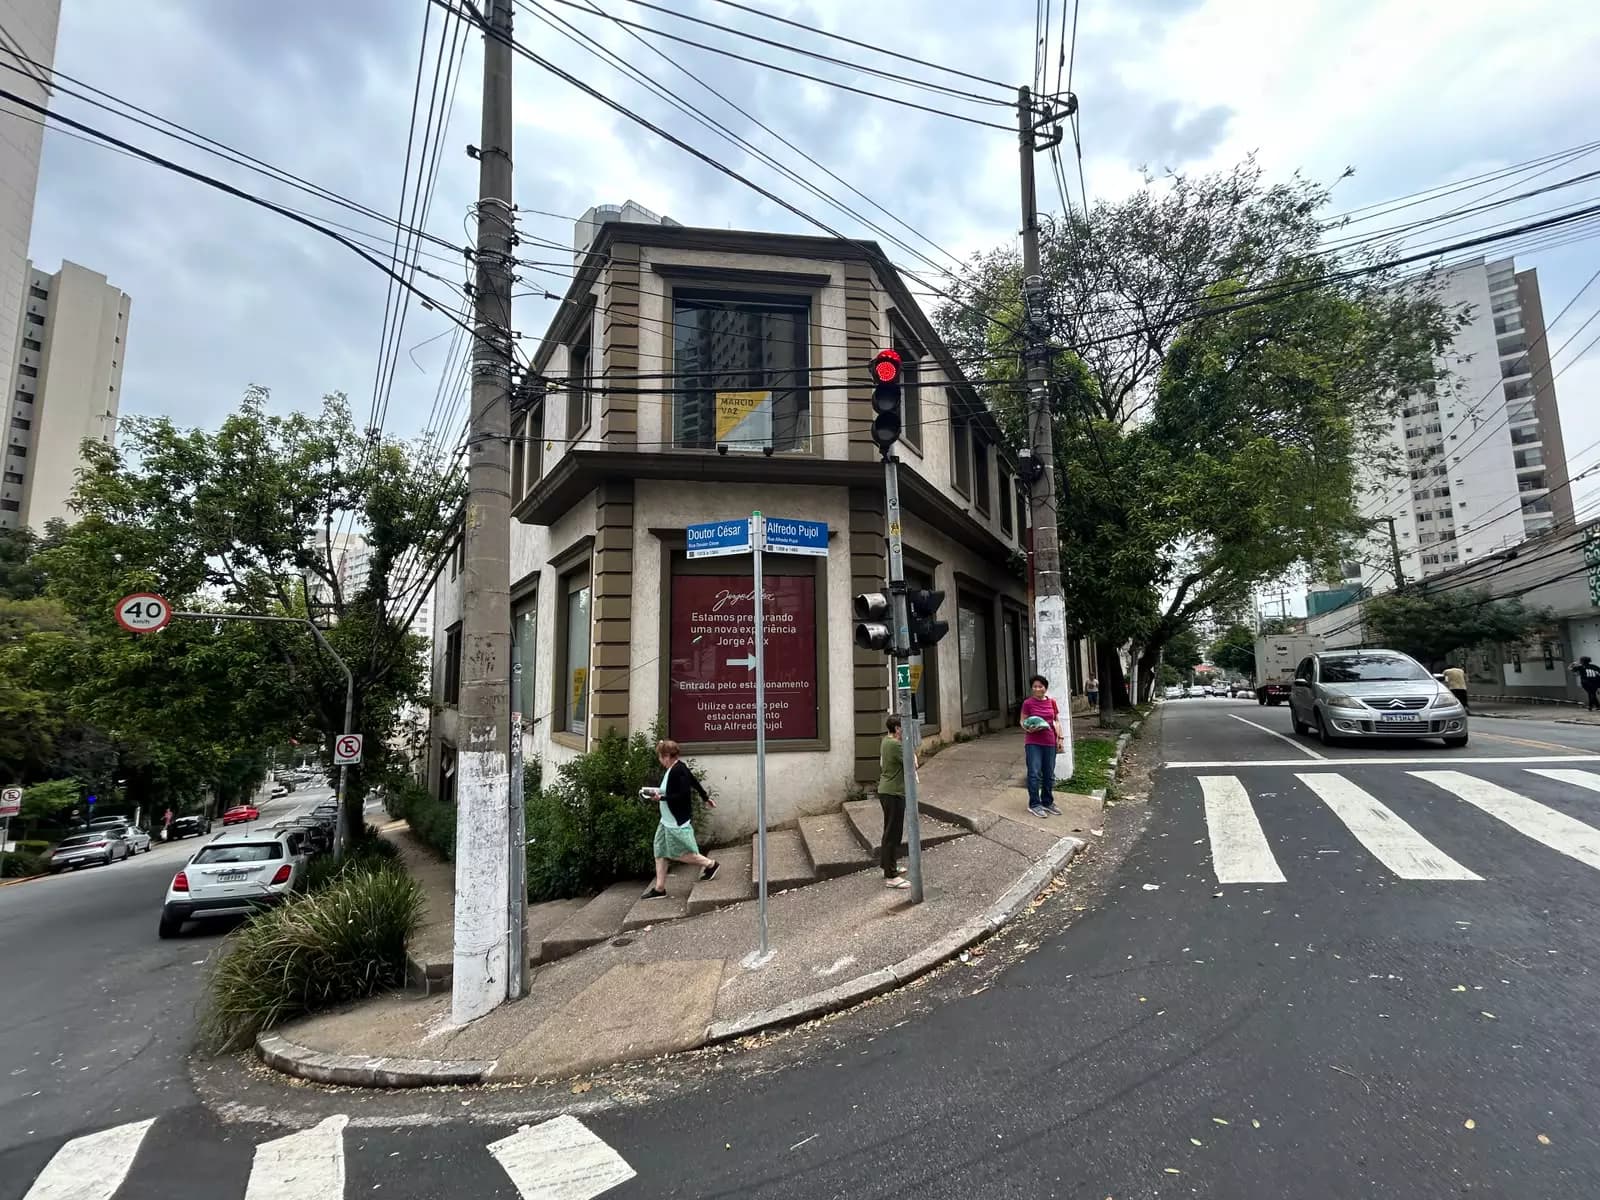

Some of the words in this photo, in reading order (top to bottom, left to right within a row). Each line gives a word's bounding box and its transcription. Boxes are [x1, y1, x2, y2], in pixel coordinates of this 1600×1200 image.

[688, 528, 715, 540] Doutor
[717, 525, 741, 536] César
[767, 522, 797, 535] Alfredo
[798, 525, 819, 539] Pujol
[124, 602, 162, 618] 40
[691, 612, 735, 622] Estamos
[736, 612, 793, 625] prerando
[690, 626, 712, 634] uma
[714, 626, 738, 634] nova
[739, 623, 797, 635] expriência
[716, 636, 745, 647] Jorge
[747, 636, 769, 645] Ax
[679, 681, 715, 690] Entrada
[717, 681, 737, 691] pelo
[739, 680, 809, 689] estaionamento
[697, 702, 727, 711] Utilize
[769, 701, 789, 710] pelo
[706, 712, 780, 721] estacionamnto
[704, 722, 722, 731] Rua
[763, 720, 783, 731] ujol
